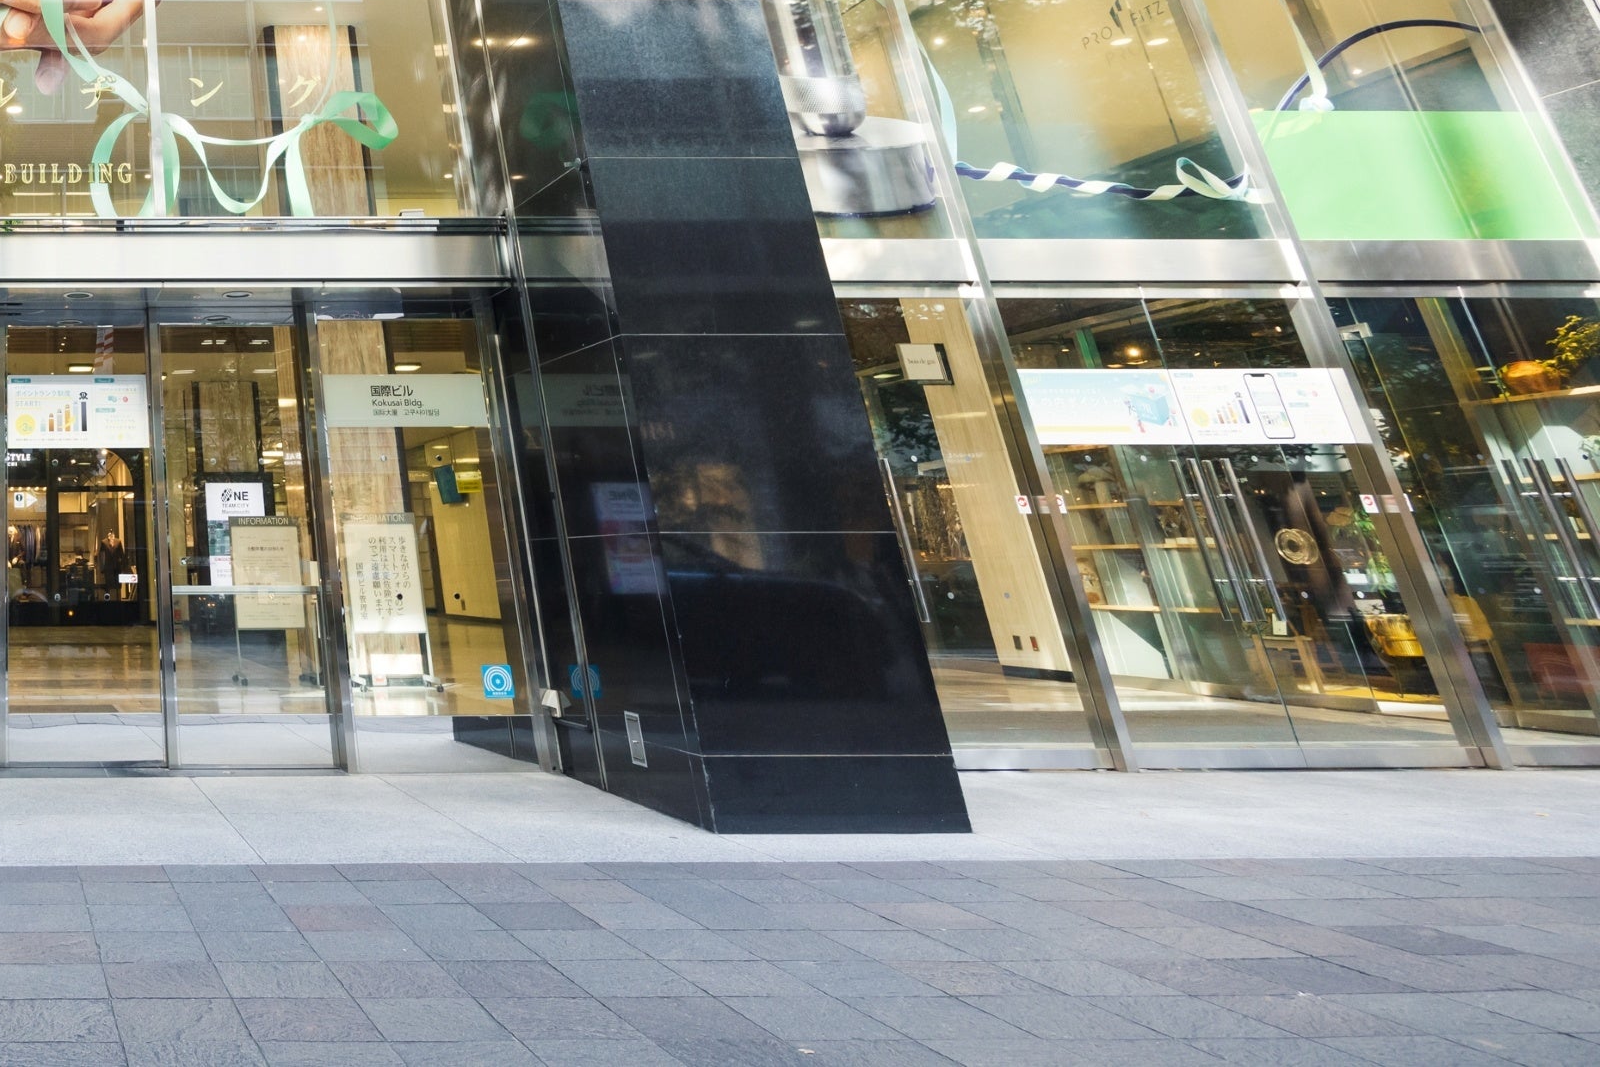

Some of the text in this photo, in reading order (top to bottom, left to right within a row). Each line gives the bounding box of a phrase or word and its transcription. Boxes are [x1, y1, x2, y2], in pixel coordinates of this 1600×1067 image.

[4, 162, 133, 185] BUILDING
[370, 385, 414, 397] 国際ビル
[372, 399, 424, 408] Kokusai Bldg.
[238, 517, 289, 525] INFORMATION
